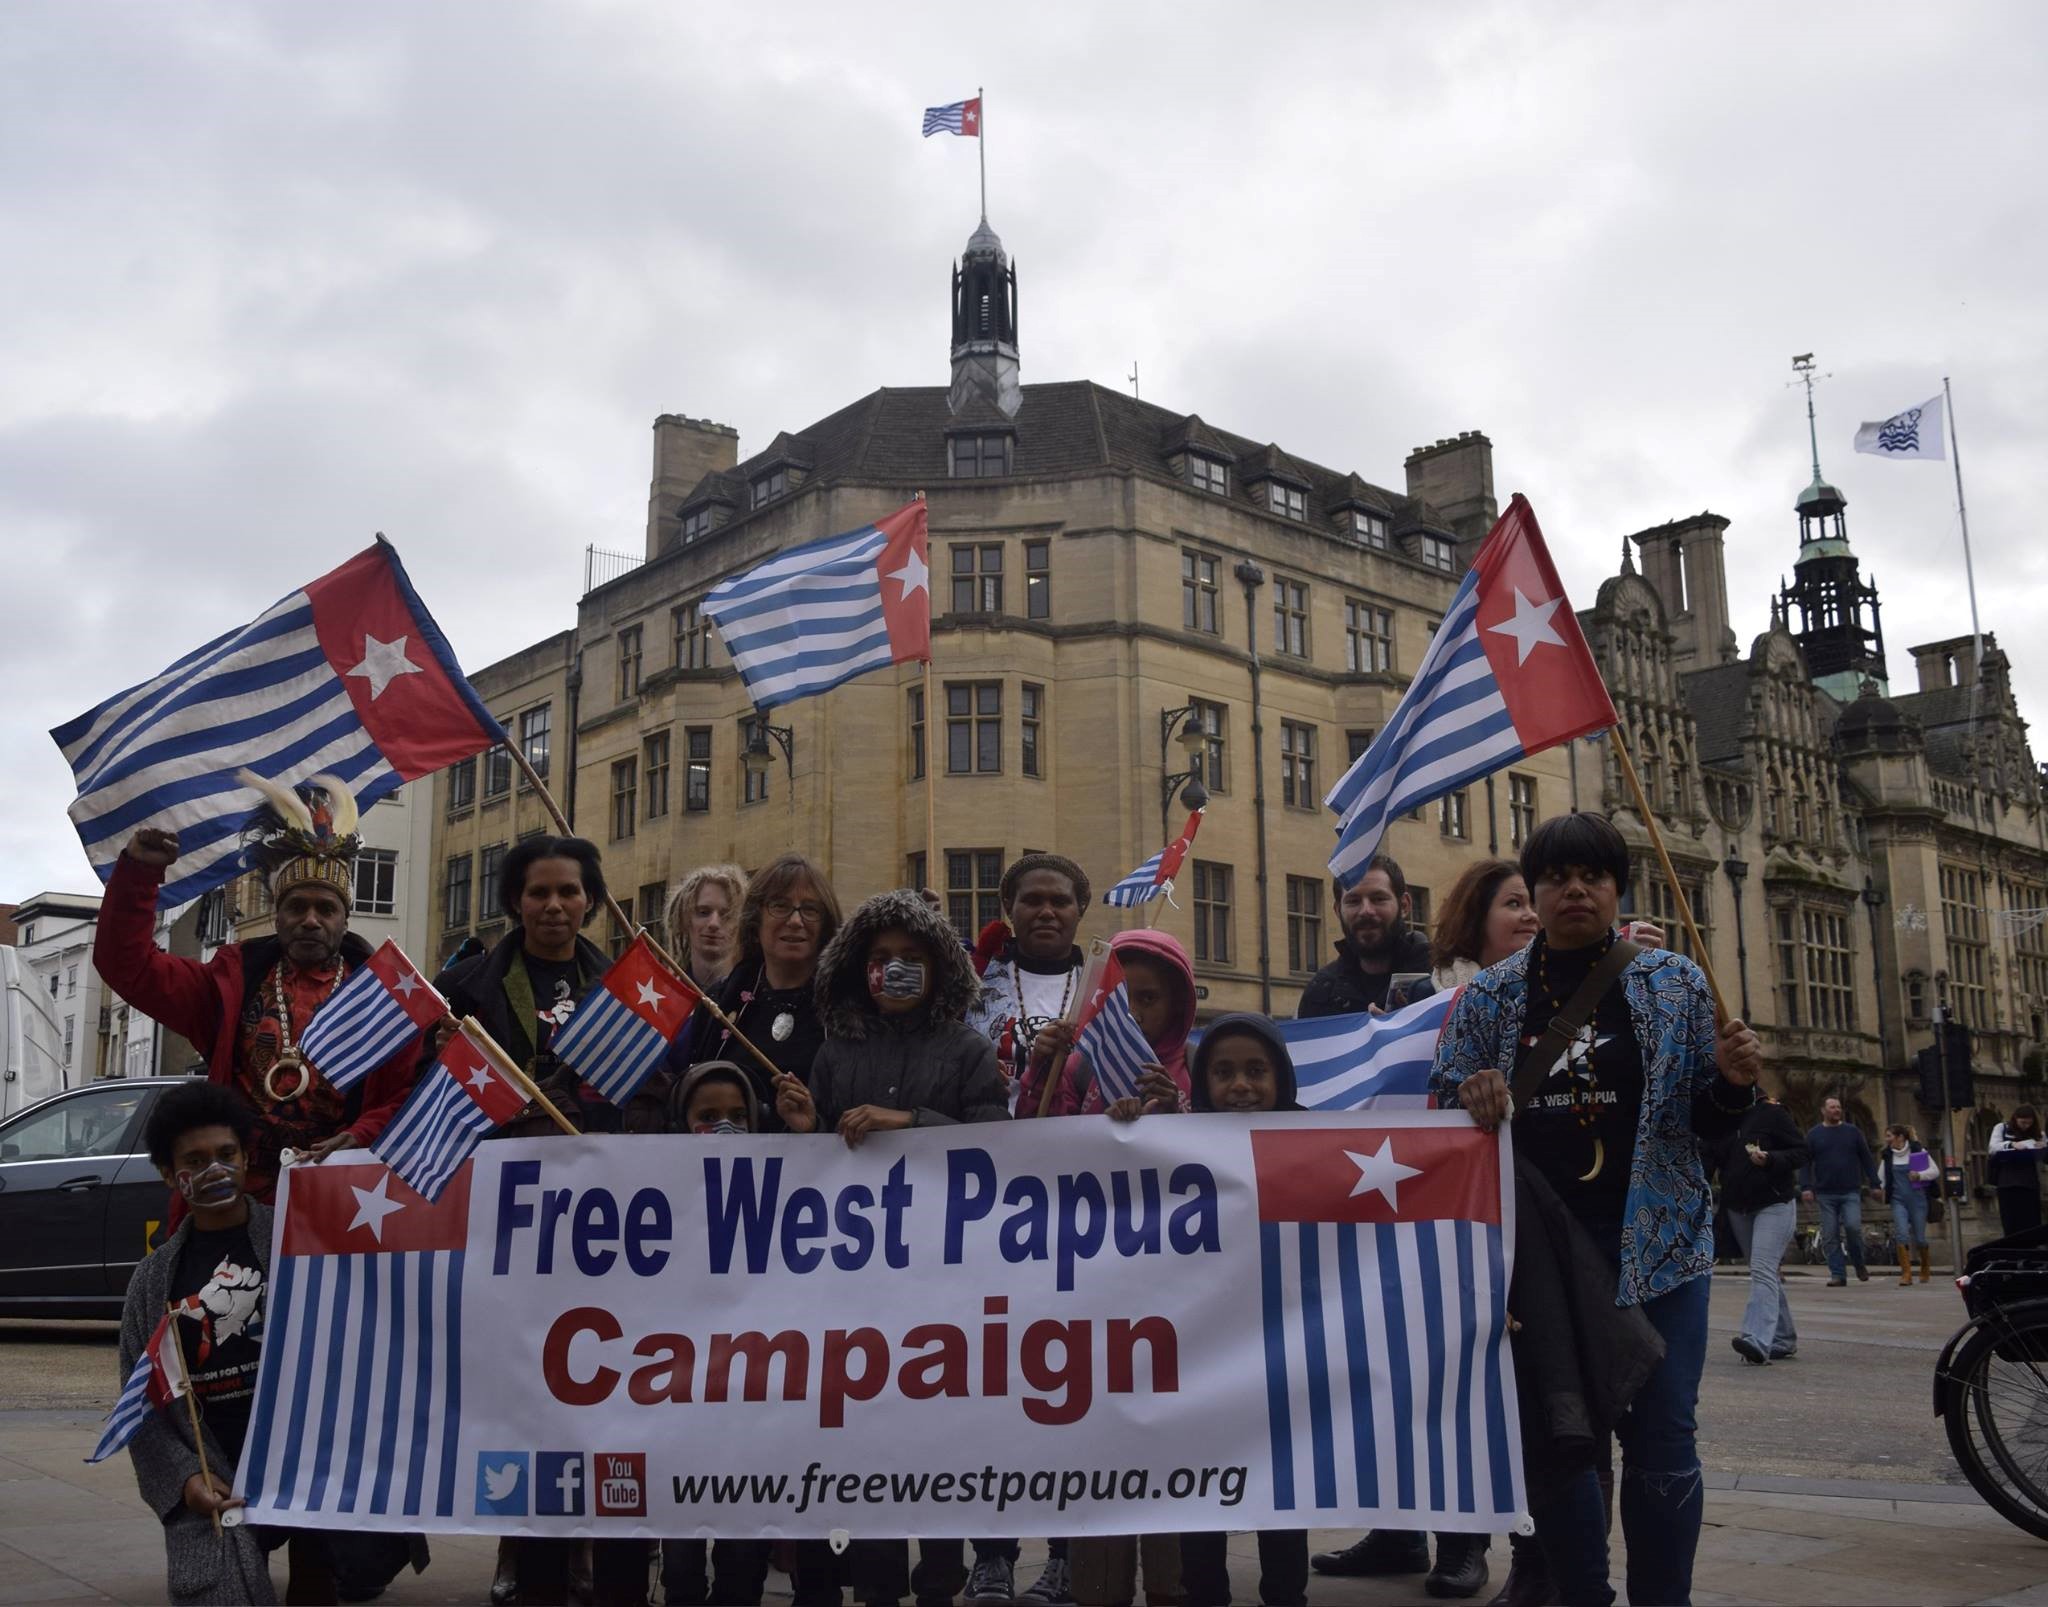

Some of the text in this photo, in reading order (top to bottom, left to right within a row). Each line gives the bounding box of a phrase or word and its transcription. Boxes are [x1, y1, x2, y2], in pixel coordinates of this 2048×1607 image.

[1544, 1094, 1575, 1107] WEST
[493, 1147, 1222, 1292] Free West Papua
[219, 1367, 239, 1377] FOR
[542, 1296, 1180, 1428] Campaign
[607, 1457, 632, 1478] You
[604, 1483, 637, 1504] Tube
[672, 1462, 1249, 1514] www.freewestpapua.org
